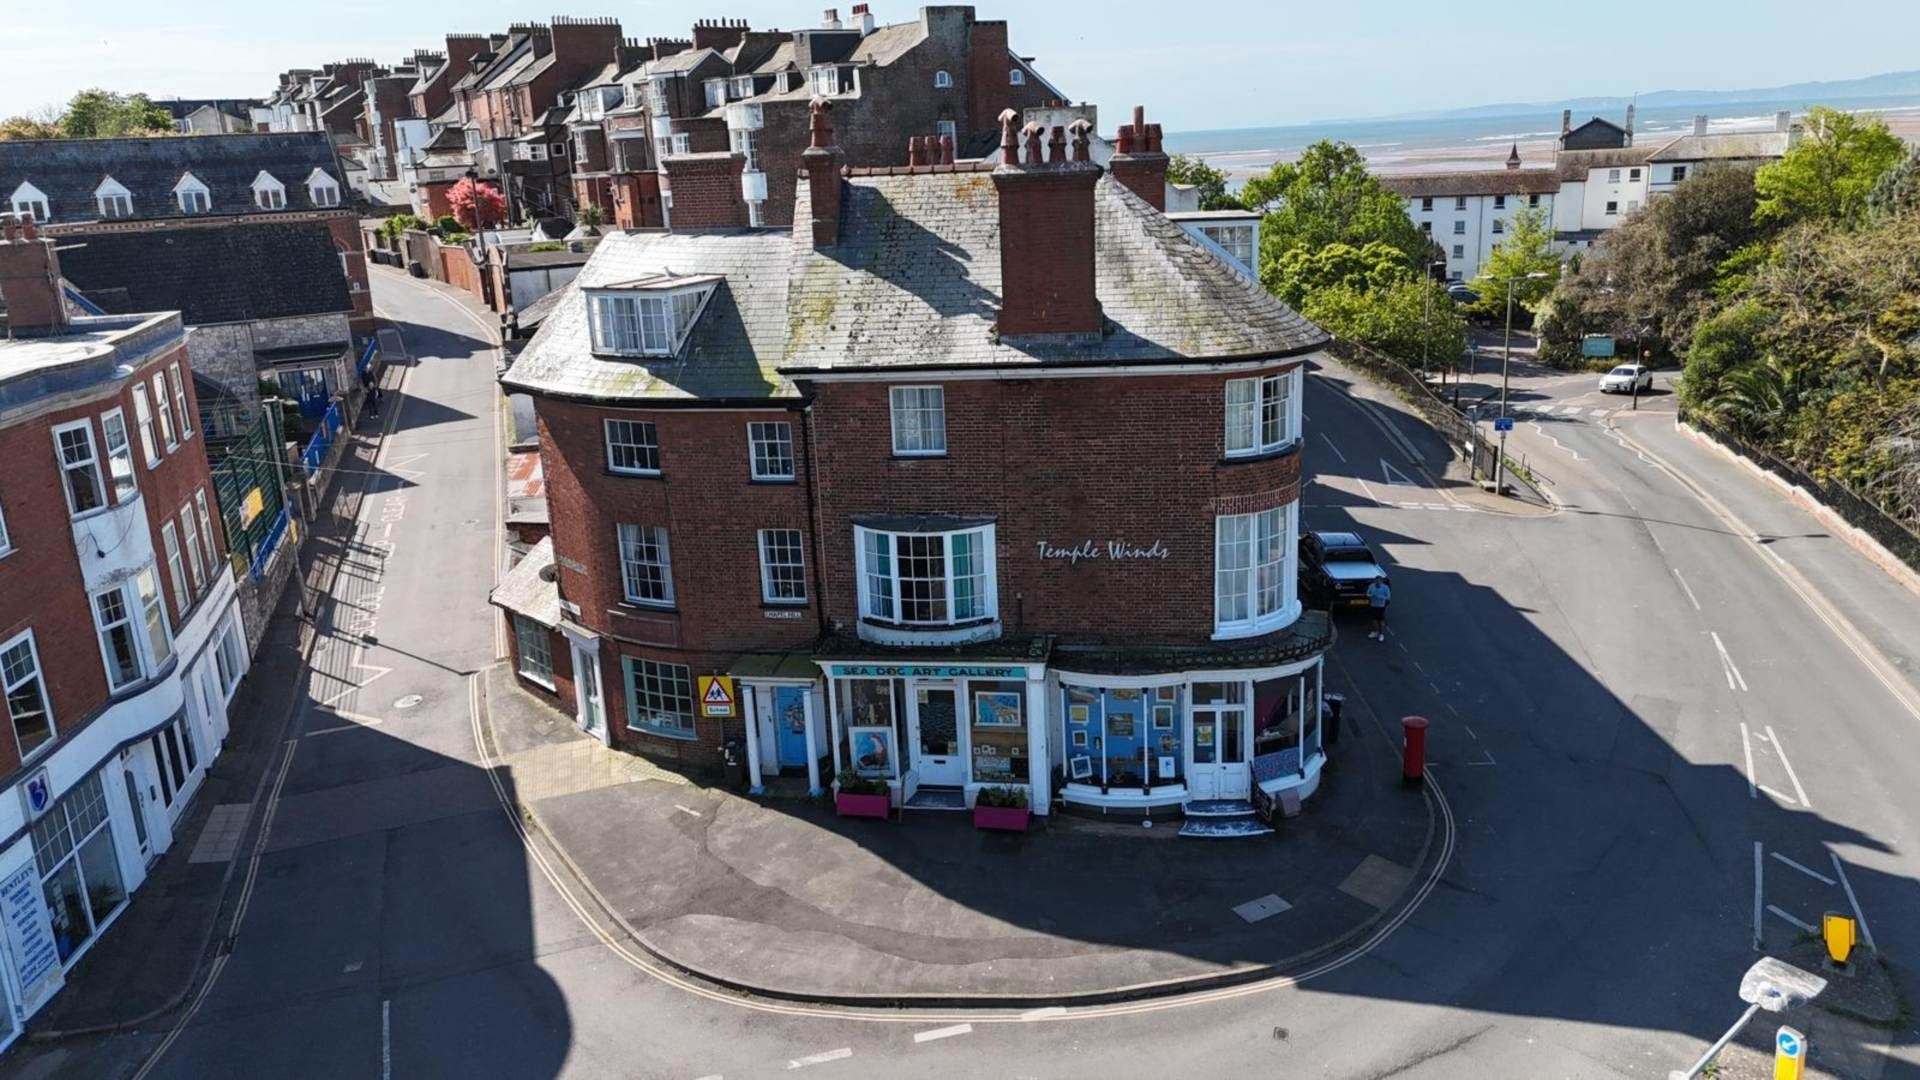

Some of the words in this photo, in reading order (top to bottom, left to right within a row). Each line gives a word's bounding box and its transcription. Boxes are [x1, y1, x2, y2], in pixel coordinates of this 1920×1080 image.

[1037, 539, 1100, 565] Temple
[1108, 540, 1170, 560] Winds
[843, 666, 868, 676] SEA
[876, 666, 905, 677] DOG
[912, 667, 941, 677] ART
[948, 667, 1013, 678] GALLERY
